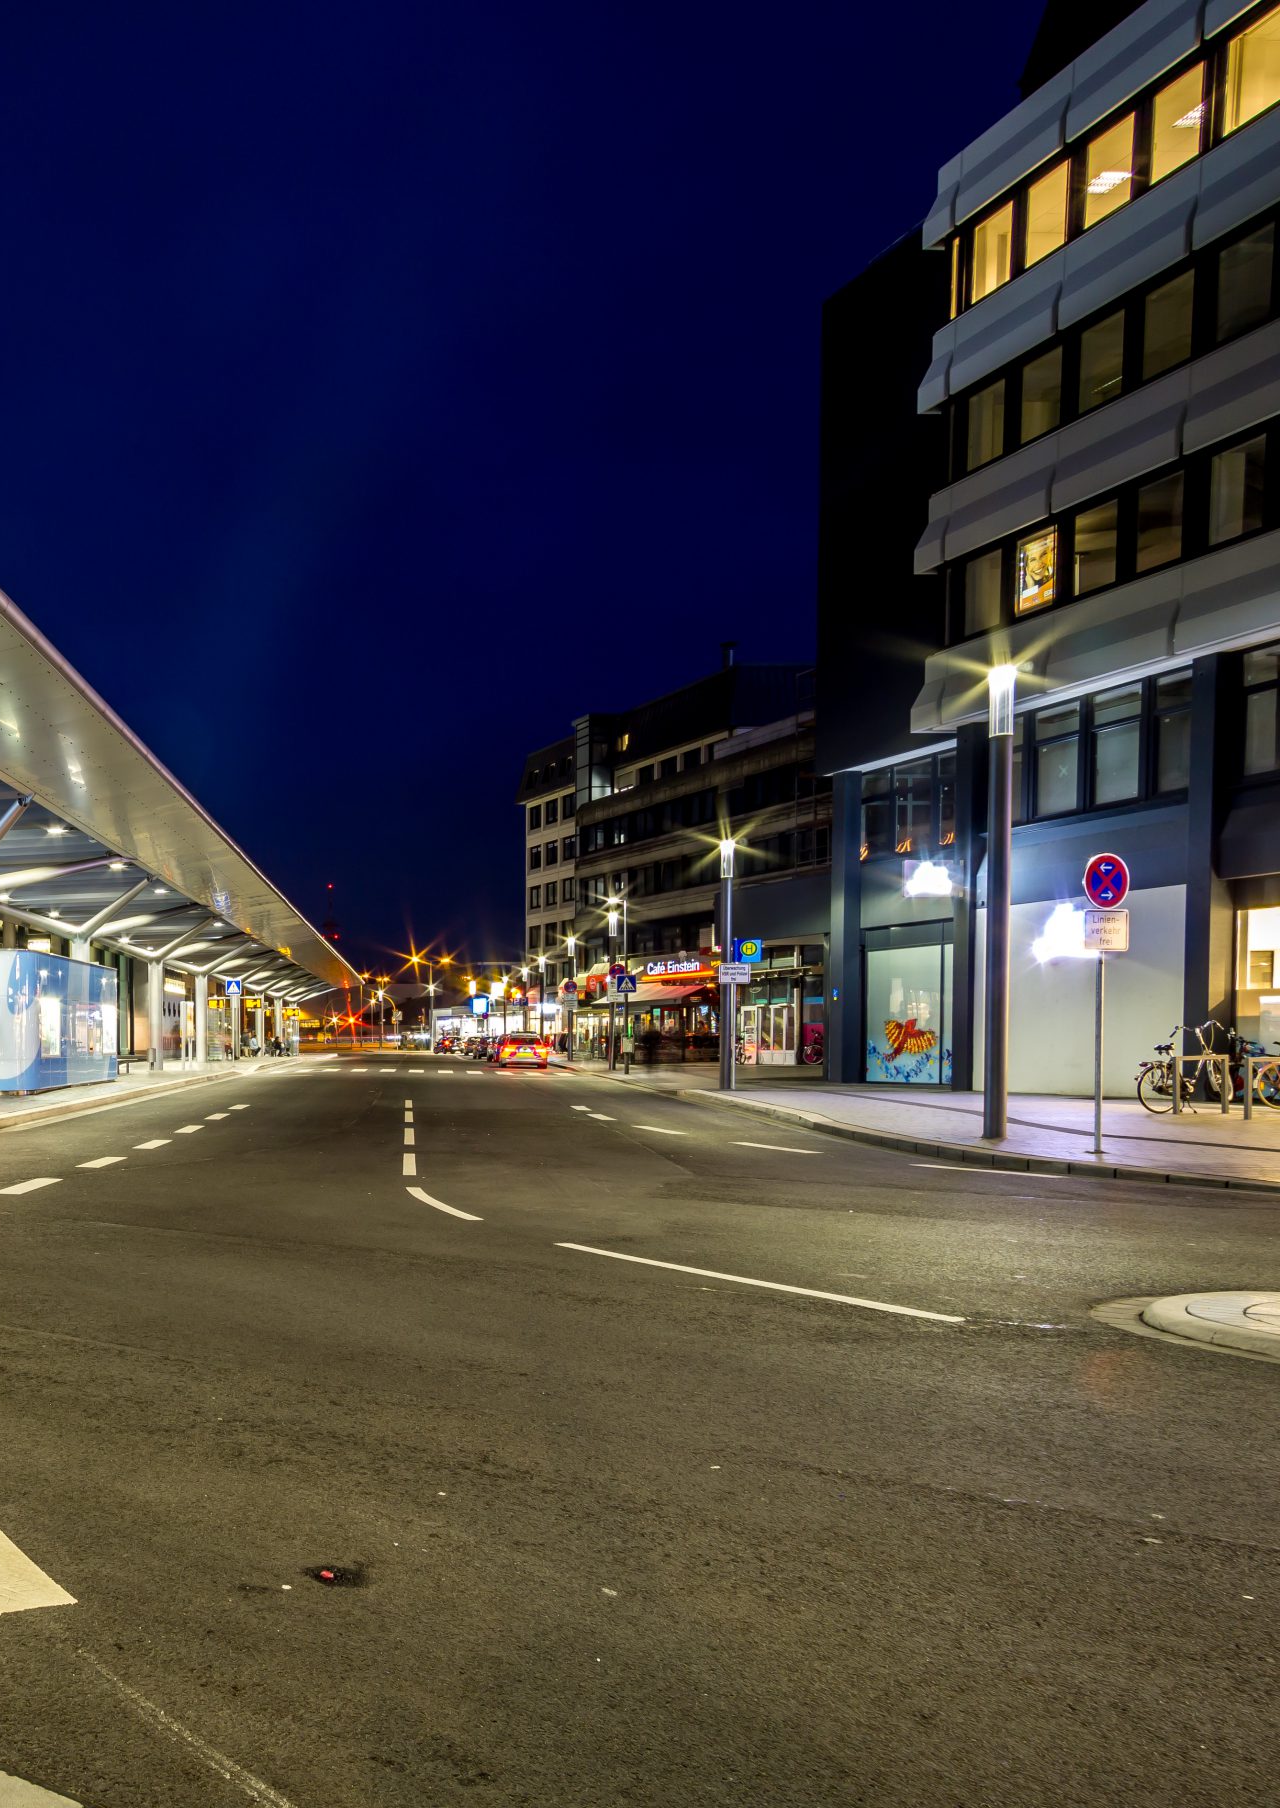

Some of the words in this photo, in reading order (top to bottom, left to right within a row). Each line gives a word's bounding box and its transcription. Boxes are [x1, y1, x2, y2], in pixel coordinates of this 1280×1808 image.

[1092, 915, 1120, 923] Linien-
[1091, 926, 1121, 935] verkehr
[1099, 937, 1113, 946] frei
[745, 944, 753, 952] H
[646, 961, 665, 975] Café
[667, 958, 700, 973] Einstein
